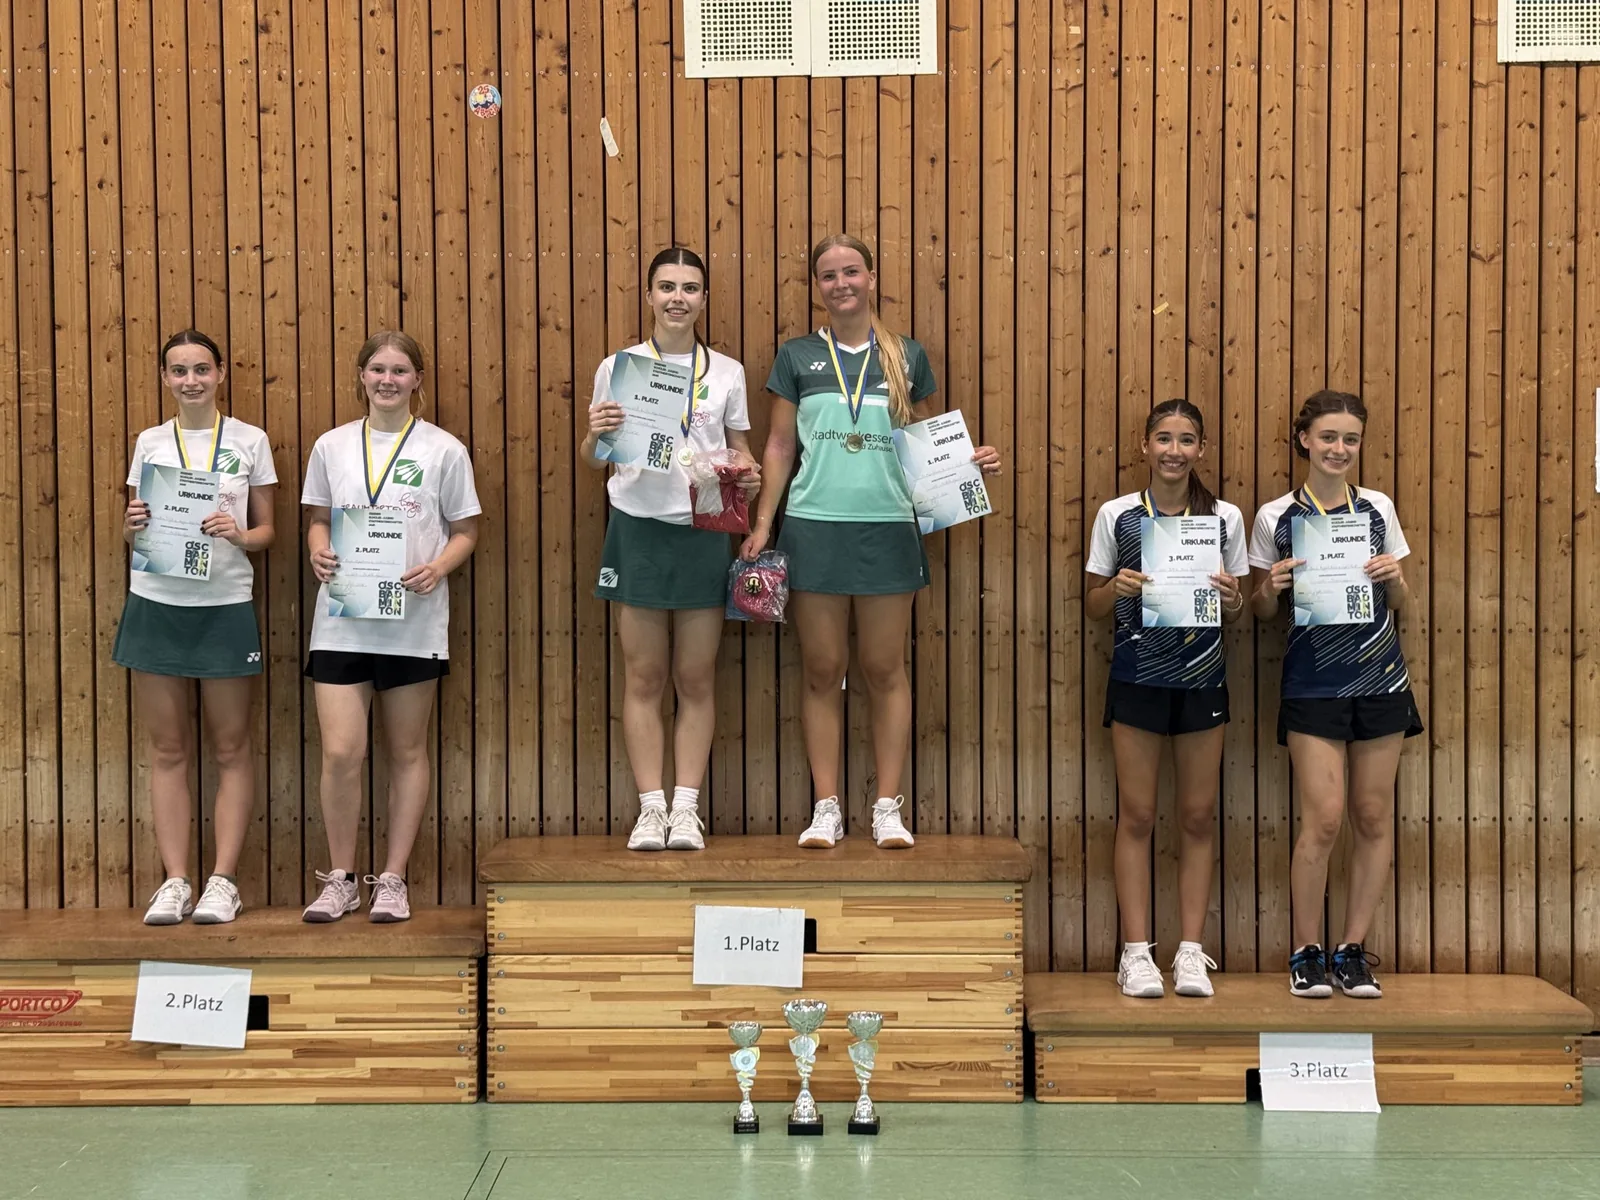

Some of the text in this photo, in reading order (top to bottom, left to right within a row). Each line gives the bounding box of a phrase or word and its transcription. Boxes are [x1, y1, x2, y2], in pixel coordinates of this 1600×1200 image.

[650, 381, 684, 394] URKUNDE
[641, 395, 659, 405] PLATZ
[933, 432, 965, 447] URKUNDE
[649, 441, 673, 452] BAD
[647, 457, 669, 470] TON
[933, 453, 951, 464] PLATZ
[178, 490, 214, 501] URKUNDE
[962, 487, 983, 500] BAD
[966, 503, 988, 516] TON
[368, 531, 402, 539] URKUNDE
[1332, 535, 1366, 543] URKUNDE
[185, 549, 209, 559] BAD
[184, 566, 207, 577] TON
[379, 590, 402, 598] BAD
[1347, 594, 1369, 602] BAD
[1194, 597, 1217, 605] BAD
[379, 606, 401, 616] TON
[1347, 611, 1371, 619] TON
[1194, 614, 1217, 623] TON
[724, 936, 779, 952] 1.Platz
[165, 993, 223, 1011] 2.Platz
[1289, 1062, 1348, 1078] 3.Platz
